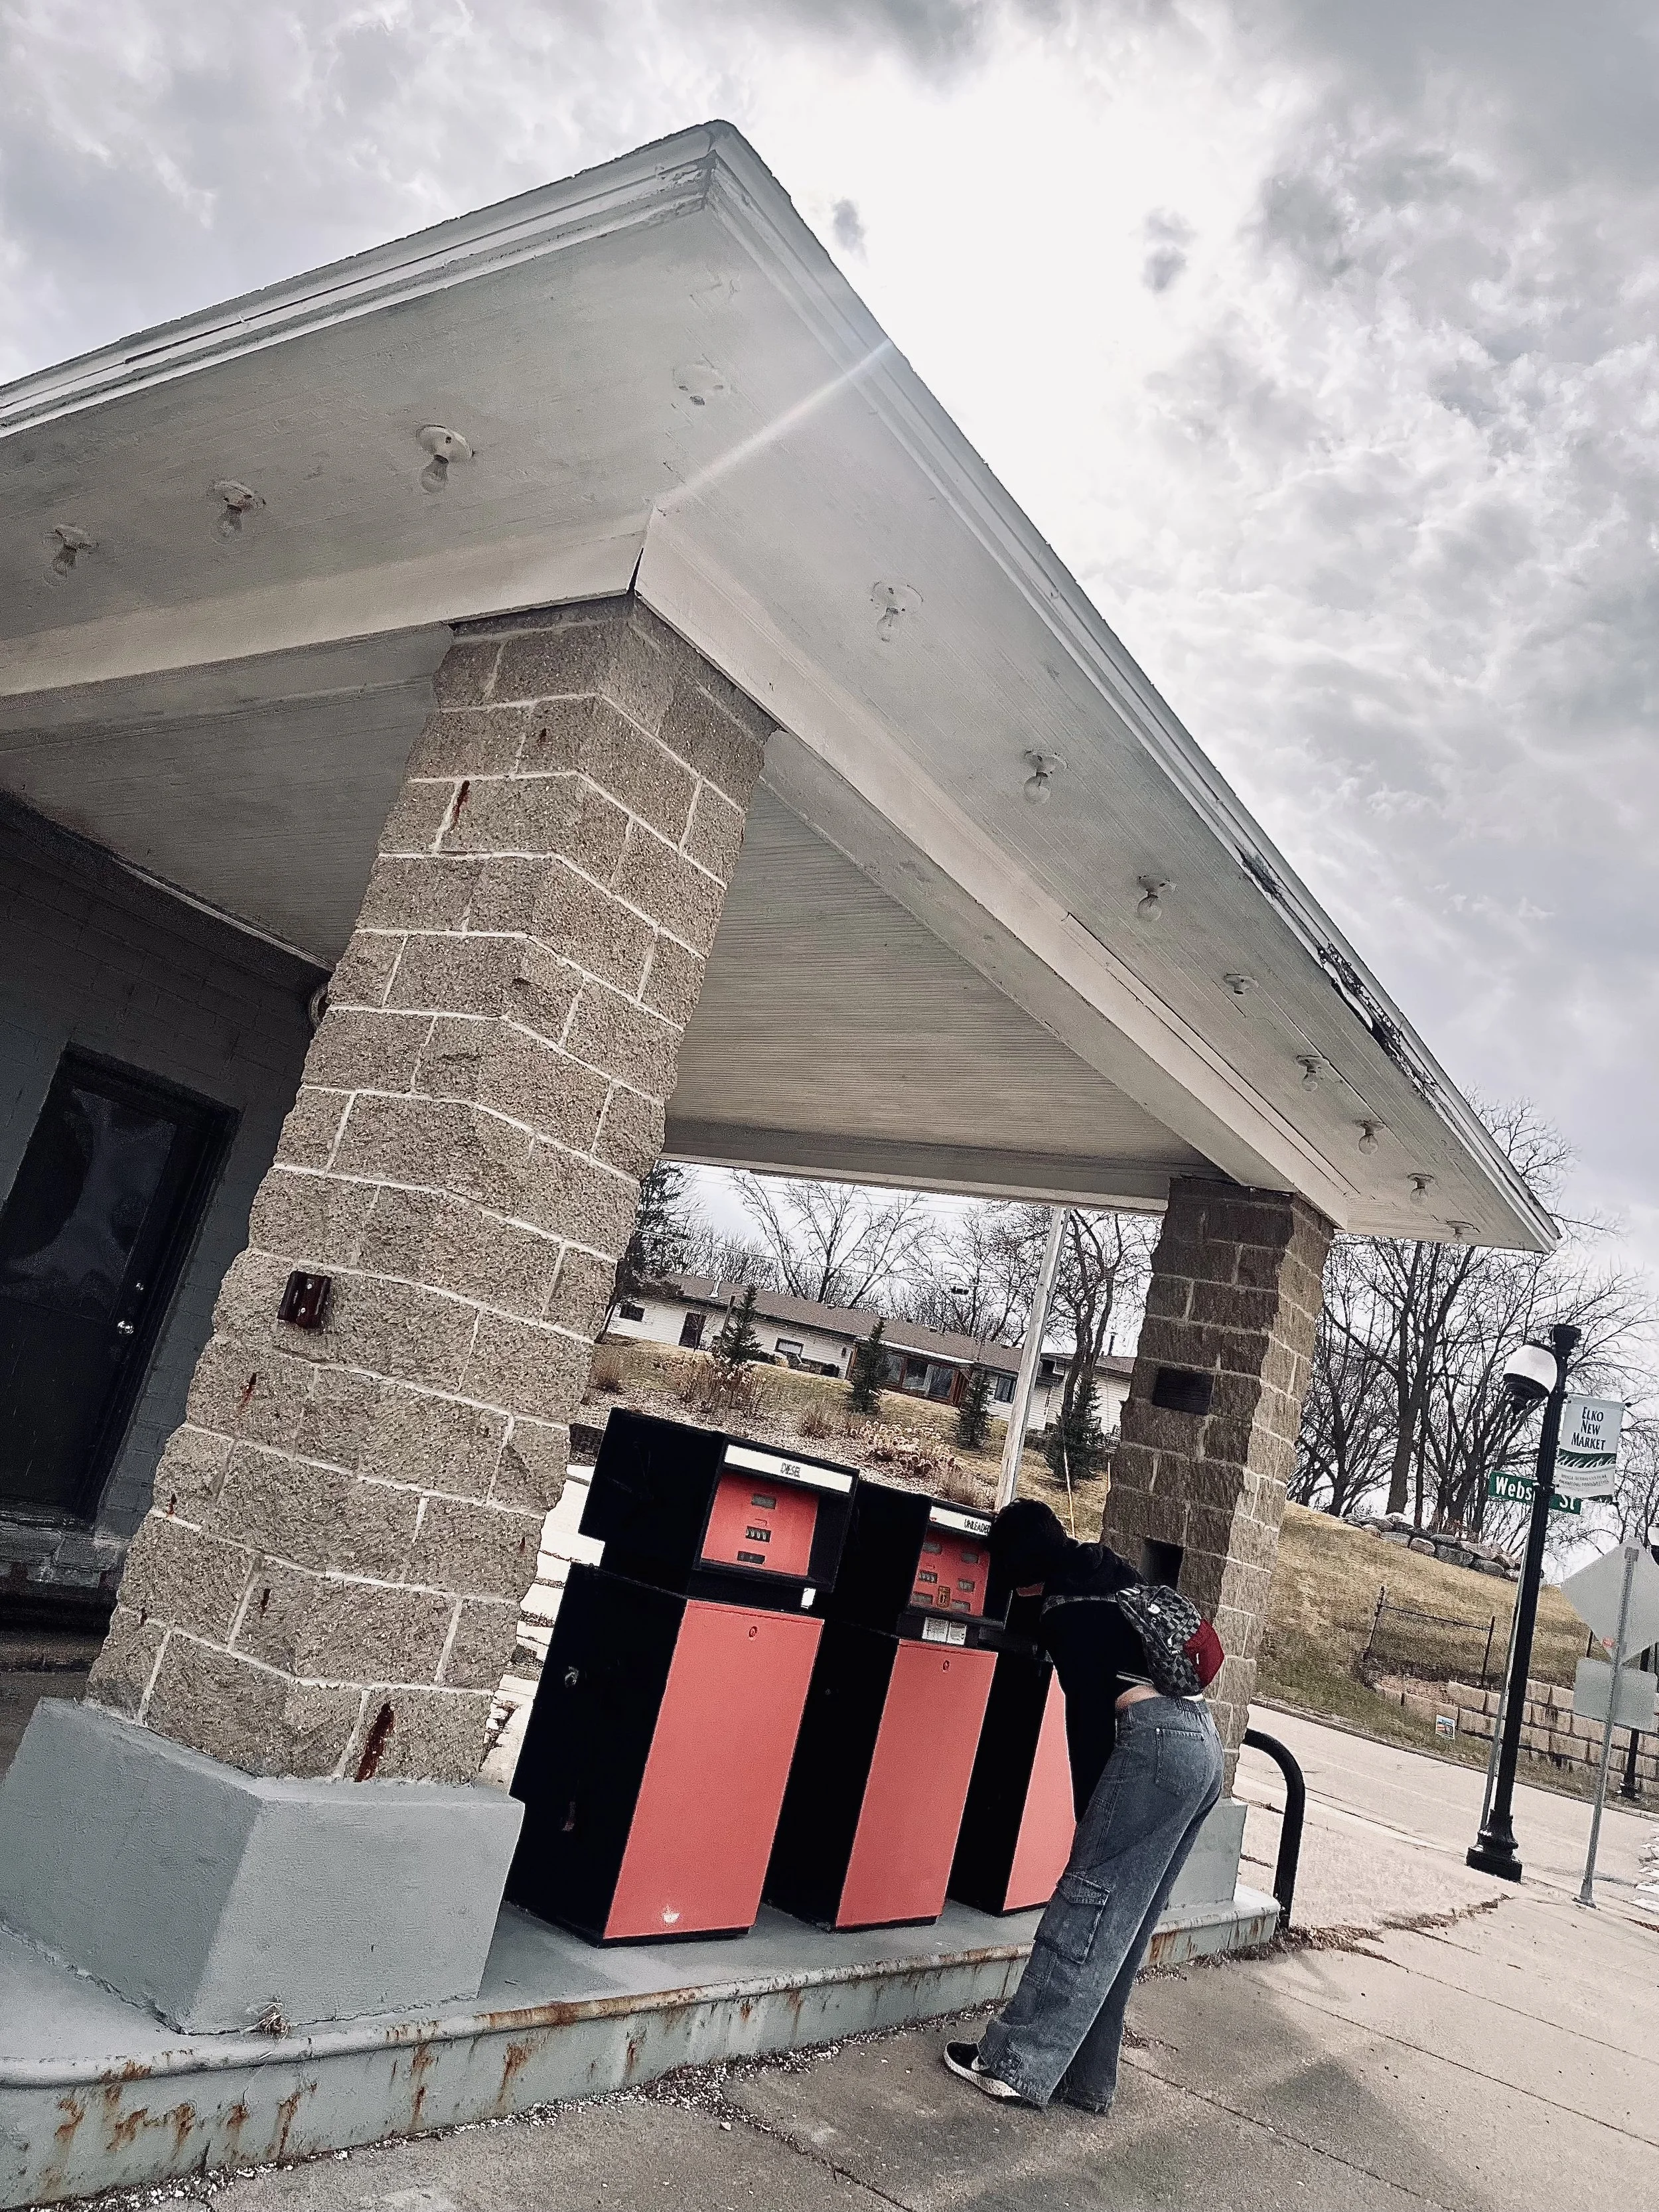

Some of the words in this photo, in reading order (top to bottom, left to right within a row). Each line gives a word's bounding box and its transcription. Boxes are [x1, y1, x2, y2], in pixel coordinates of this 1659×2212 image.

[1571, 1432, 1606, 1451] MARKET
[780, 1462, 801, 1478] DIESEL
[1496, 1476, 1533, 1501] Webs
